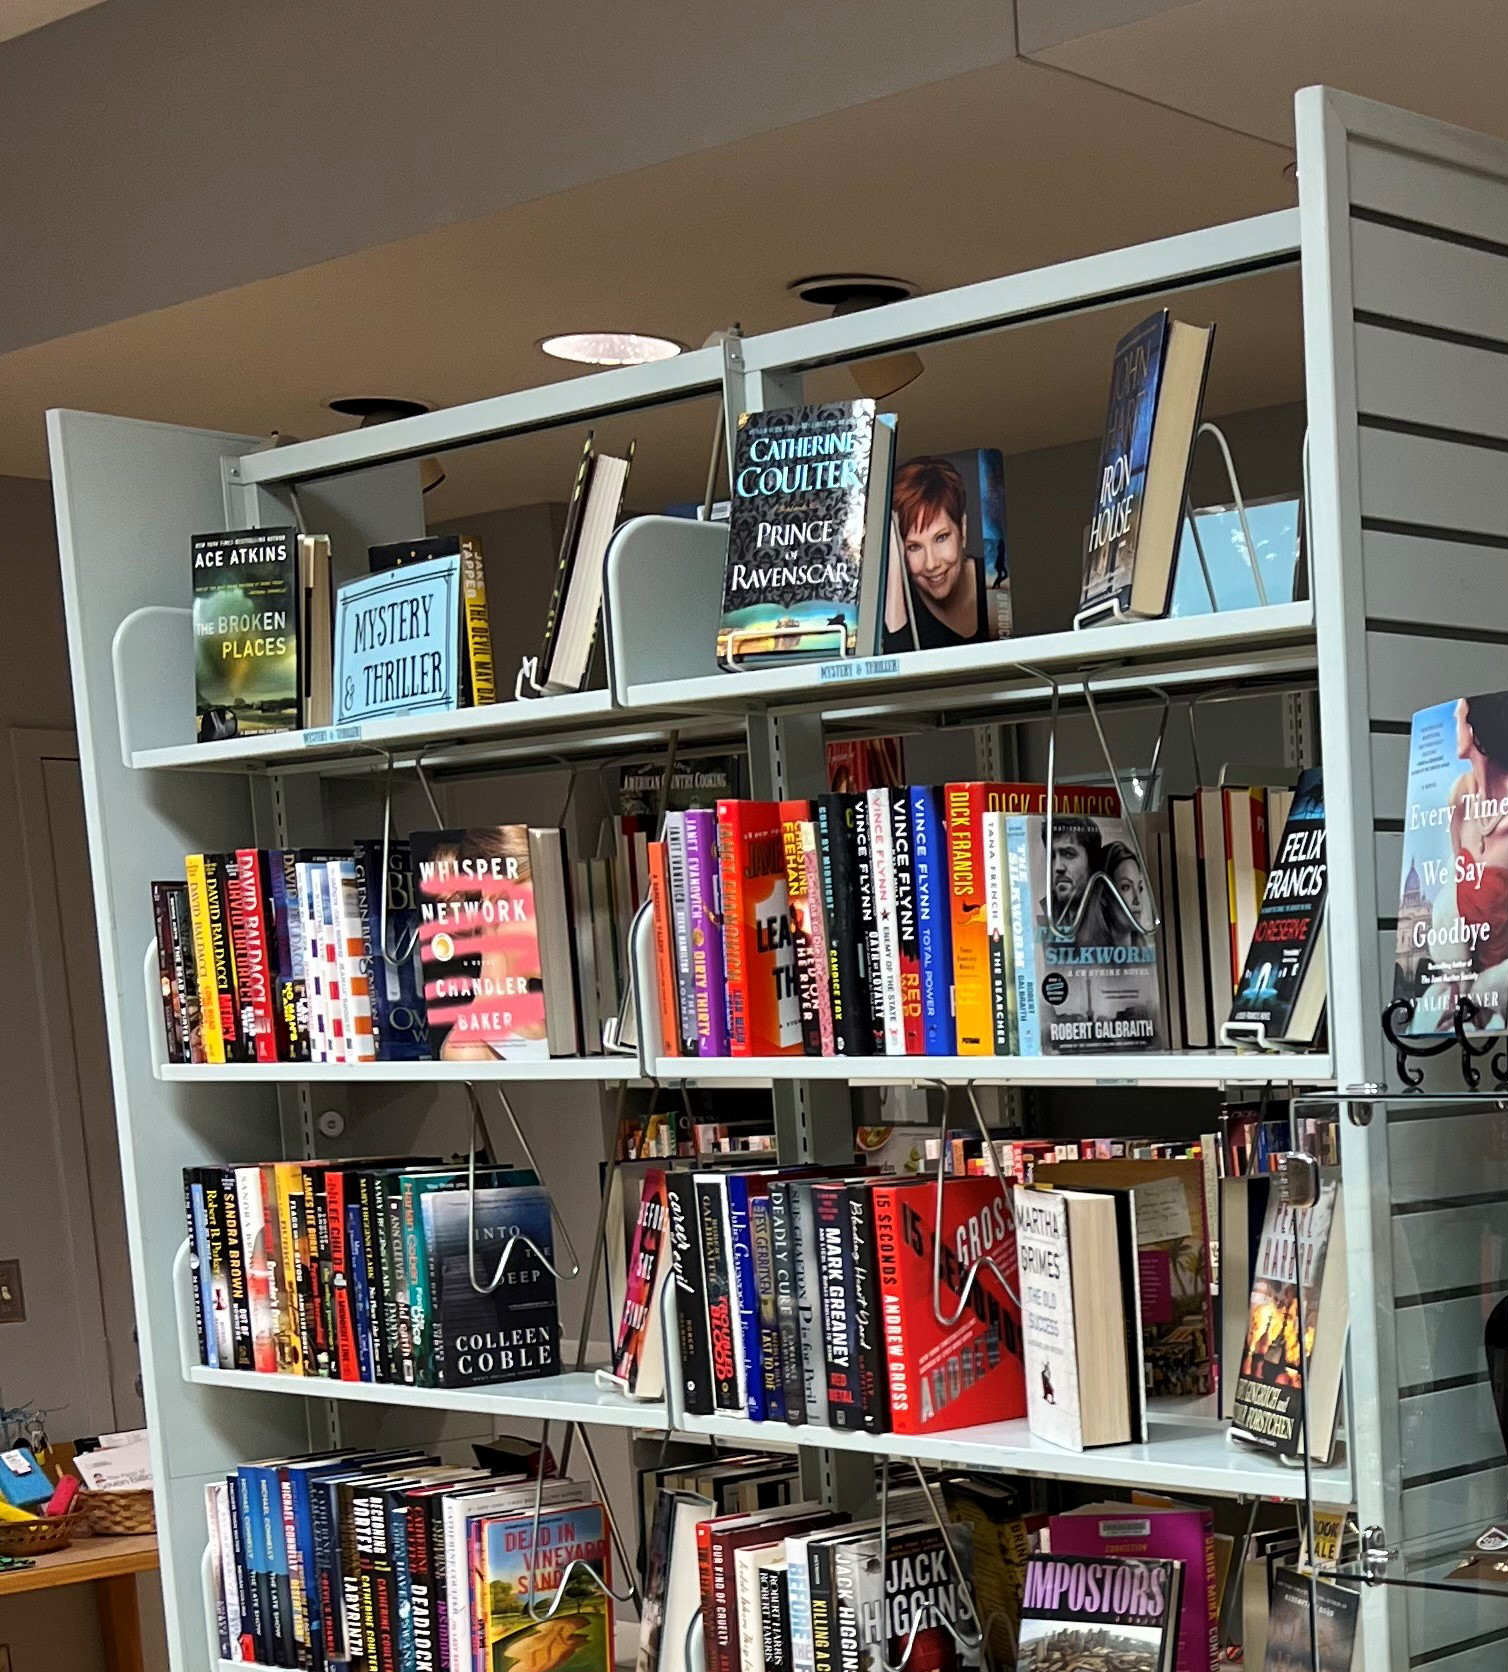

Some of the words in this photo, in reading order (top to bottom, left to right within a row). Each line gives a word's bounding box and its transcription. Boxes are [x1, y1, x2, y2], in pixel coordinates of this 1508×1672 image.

[750, 432, 856, 461] CATHERINE
[737, 460, 860, 497] COULTER
[757, 521, 832, 547] PRINCE
[1089, 495, 1133, 552] HOUSE
[195, 549, 224, 569] ACE
[229, 545, 287, 565] ATKINS
[218, 611, 286, 634] BROKEN
[355, 594, 433, 654] MYSTERY
[222, 637, 286, 660] PLACES
[821, 662, 852, 679] MYSTERY
[856, 663, 862, 674] &
[866, 660, 898, 673] THRILLER
[363, 651, 443, 707] THRILLER
[914, 798, 927, 857] VINCE
[949, 792, 971, 827] DICK
[1410, 802, 1456, 832] Every
[686, 818, 700, 851] JANET
[894, 800, 910, 867] VINCE
[1280, 829, 1327, 863] FELIX
[420, 857, 518, 884] WHISPER
[952, 831, 974, 896] FRANCIS
[1264, 865, 1326, 899] FRANCIS
[1422, 859, 1448, 886] We
[1454, 855, 1486, 890] Say
[206, 878, 222, 920] DAVID
[687, 858, 703, 919] EVANOVICH
[899, 872, 915, 941] FLYNN
[917, 863, 931, 920] FLYNN
[236, 856, 258, 911] DAVID
[247, 915, 266, 1003] BALDACCI
[421, 900, 527, 925] NETWORK
[1413, 916, 1491, 950] Goodbye
[213, 923, 228, 989] BALDACCI
[922, 928, 932, 965] TOTAL
[993, 951, 1002, 975] THE
[1045, 946, 1155, 965] SILKWORM
[436, 978, 528, 997] CHANDLER
[693, 951, 708, 987] DIRTY
[697, 992, 711, 1036] THIRTY
[925, 971, 936, 1016] POWER
[995, 979, 1006, 1044] SEARCHER
[457, 1012, 512, 1031] BAKER
[1051, 1022, 1094, 1040] ROBERT
[1095, 1020, 1153, 1039] GALBRAITH
[224, 1193, 238, 1245] SANDRA
[770, 1192, 788, 1262] DEADLY
[826, 1228, 844, 1281] MARK
[877, 1214, 898, 1286] SECONDS
[229, 1250, 243, 1298] BROWN
[455, 1326, 550, 1352] COLLEEN
[829, 1286, 849, 1367] GREANEY
[883, 1295, 905, 1359] ANDREW
[457, 1346, 552, 1375] COBLE
[889, 1360, 908, 1412] GROSS
[885, 1549, 947, 1594] JACK
[1023, 1560, 1166, 1616] IMPOSTORS
[343, 1576, 363, 1656] LABYRINTH
[410, 1584, 433, 1672] DEADLOCK
[812, 1600, 831, 1647] KILLING
[863, 1580, 974, 1644] HIGGINS
[816, 1651, 831, 1659] A
